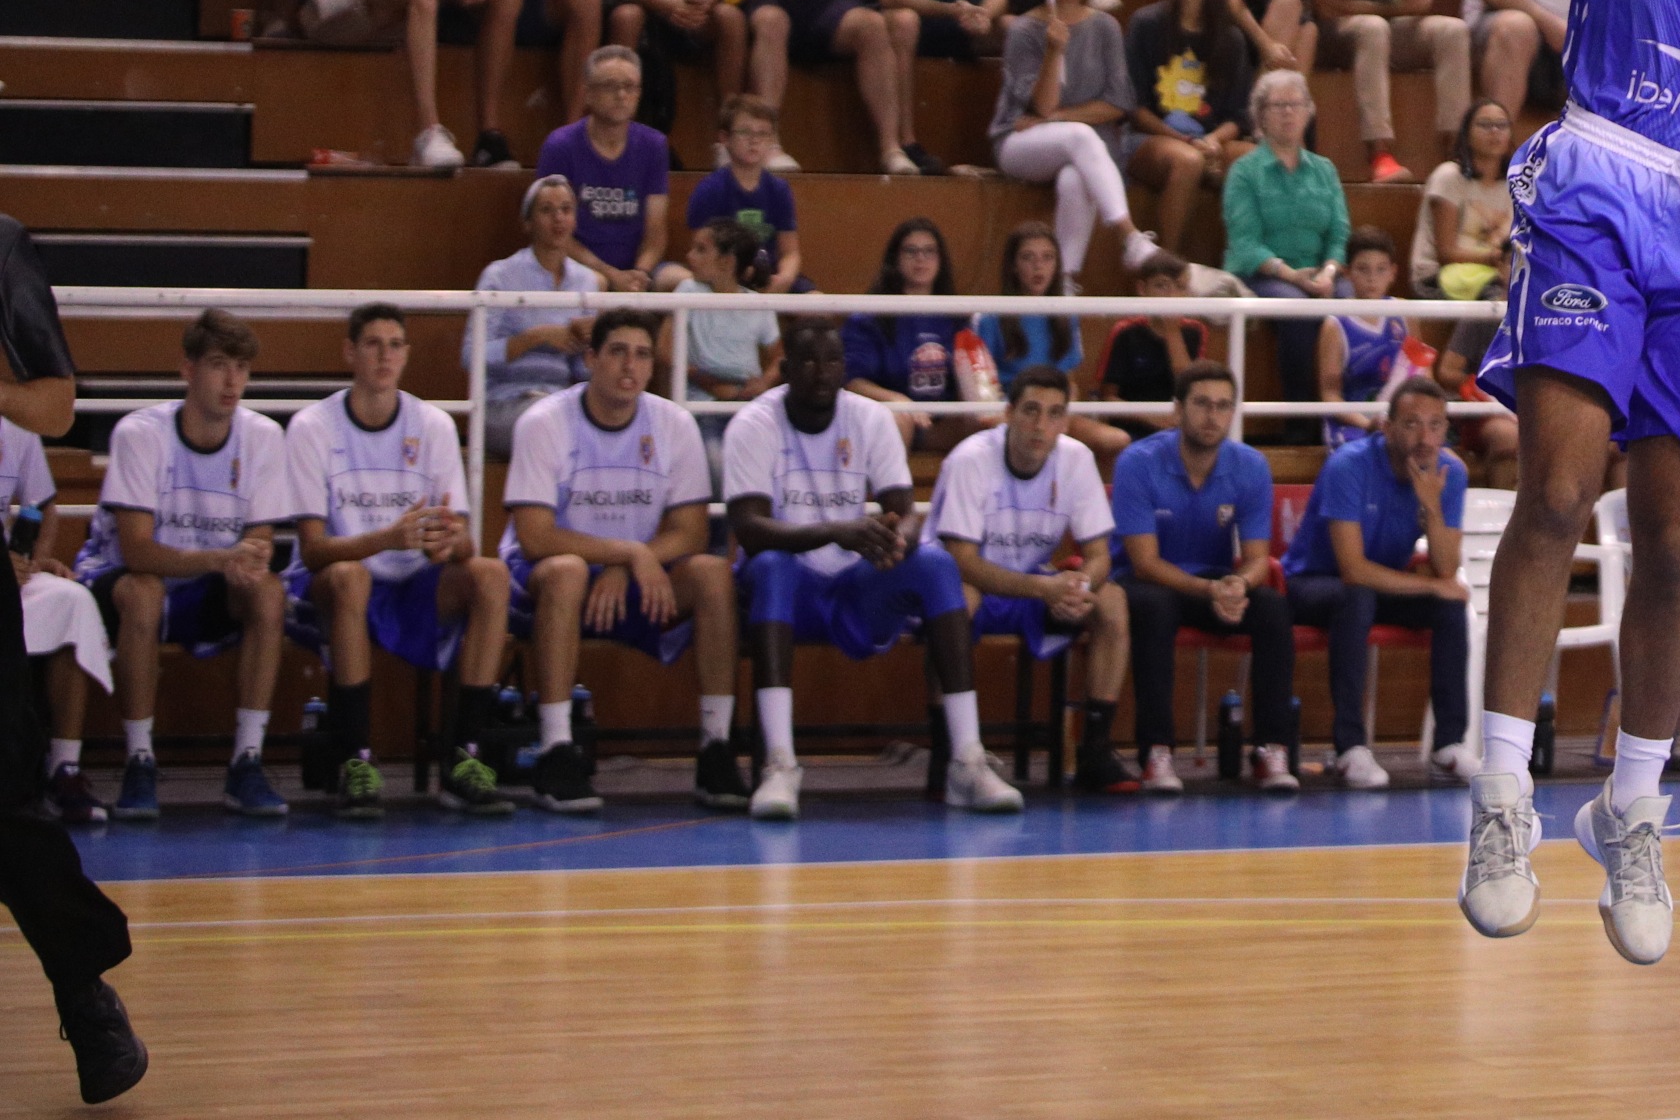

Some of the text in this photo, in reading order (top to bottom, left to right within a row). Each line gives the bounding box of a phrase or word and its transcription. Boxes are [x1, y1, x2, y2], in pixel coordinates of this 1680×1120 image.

[1552, 288, 1592, 309] Ford
[1534, 316, 1610, 332] Tarraco Center
